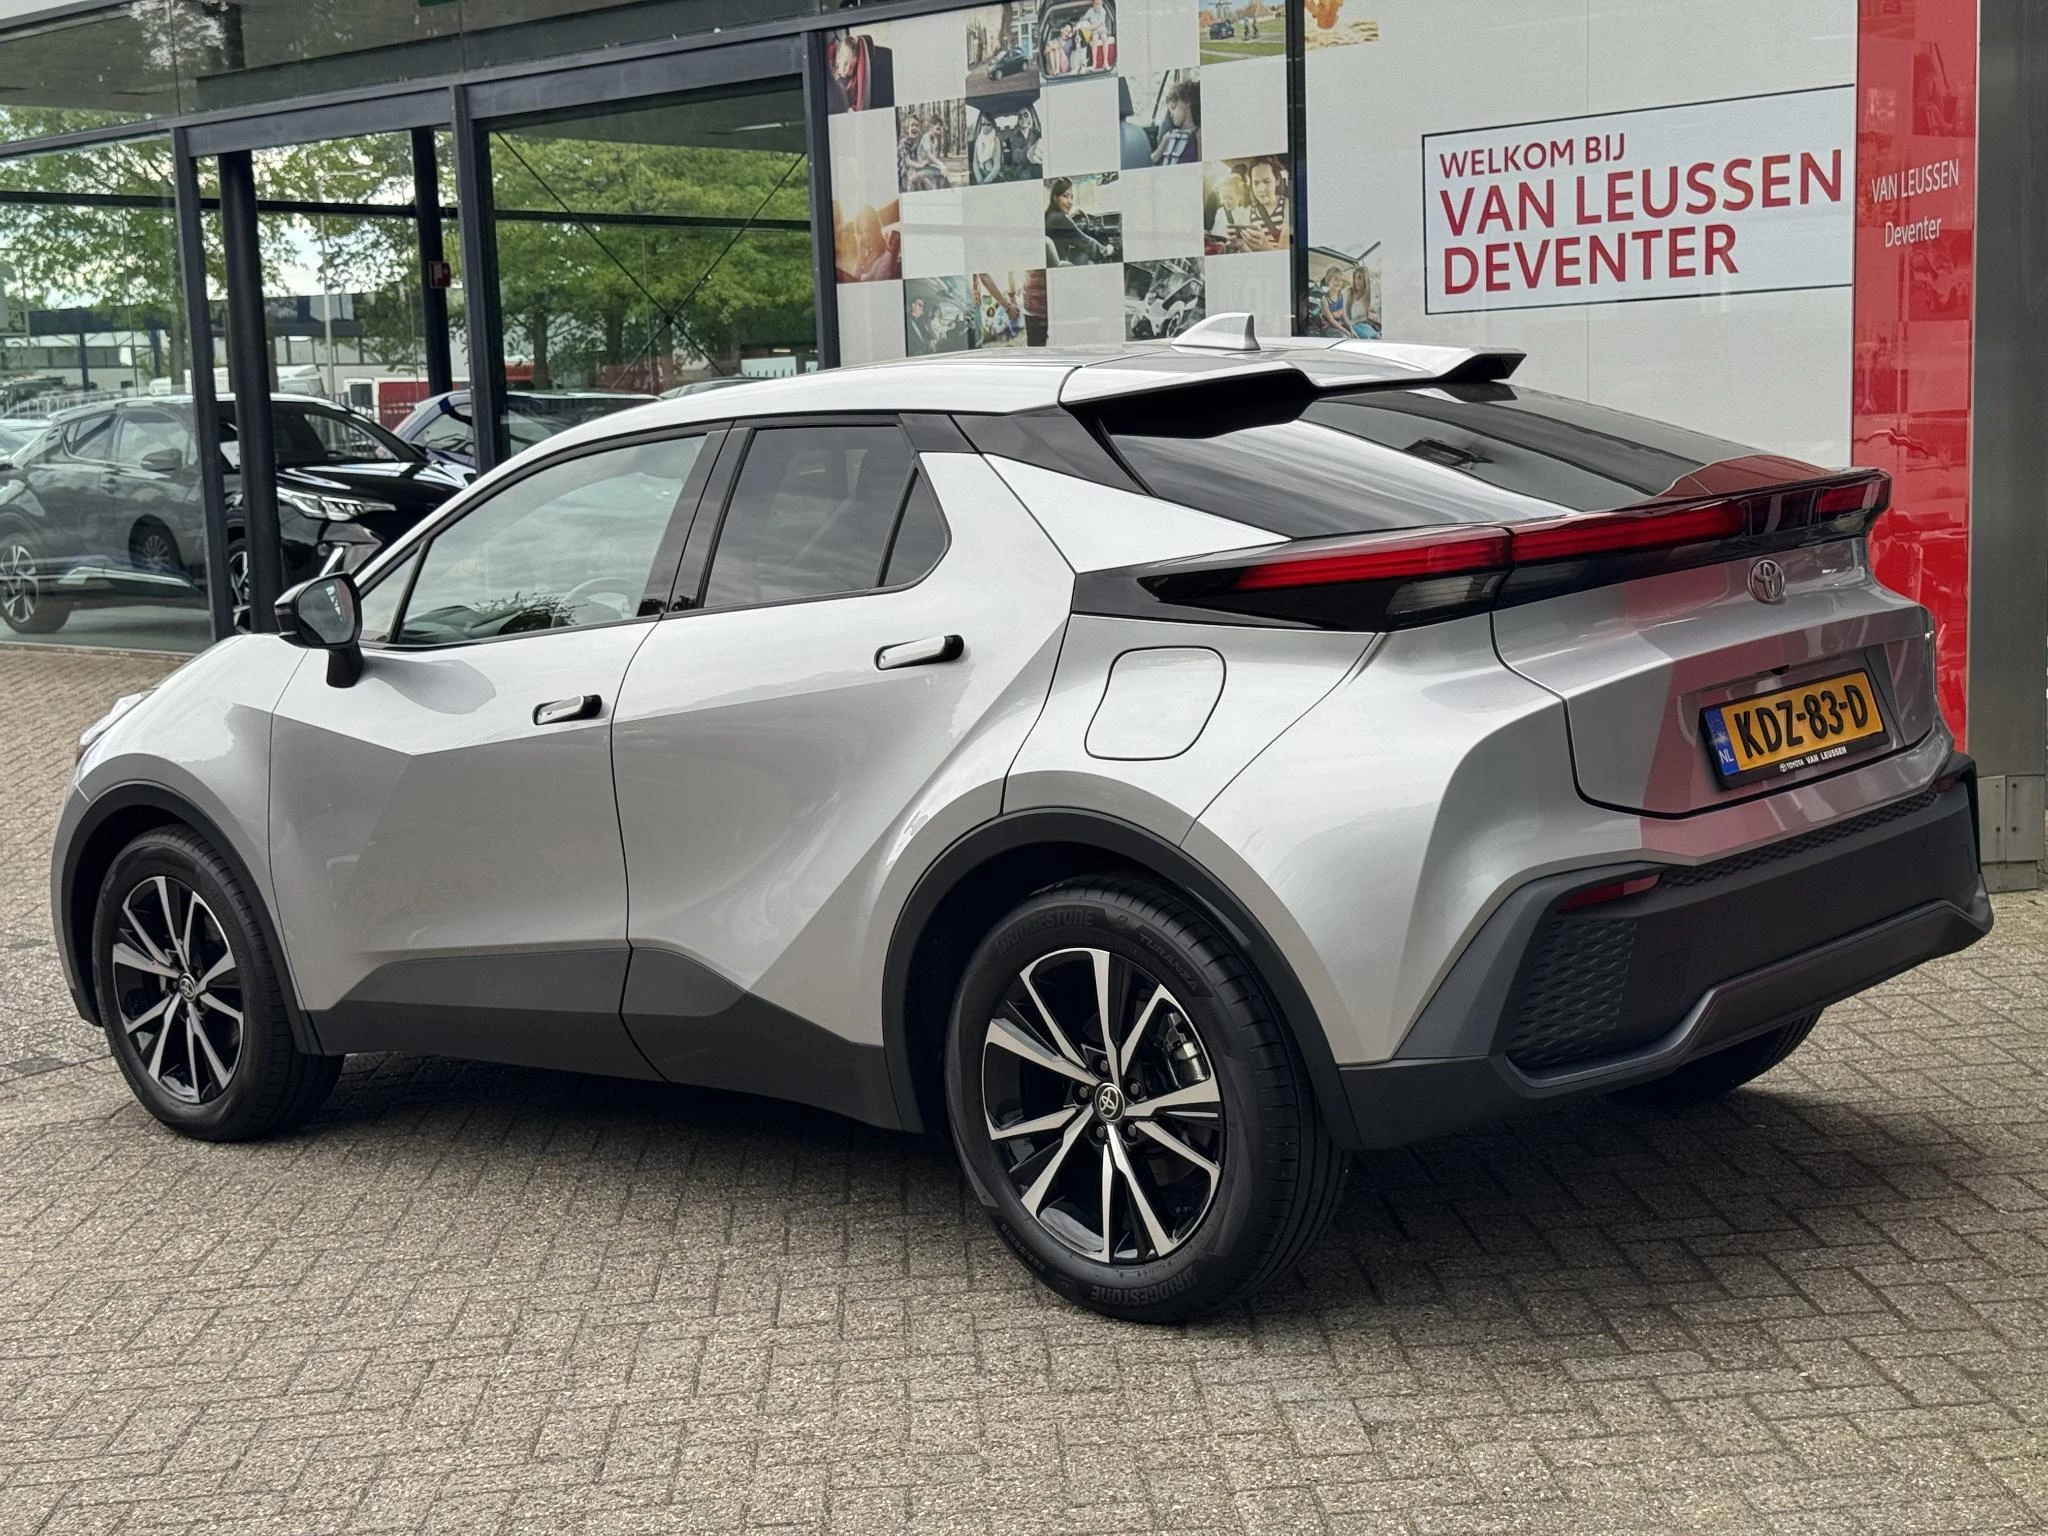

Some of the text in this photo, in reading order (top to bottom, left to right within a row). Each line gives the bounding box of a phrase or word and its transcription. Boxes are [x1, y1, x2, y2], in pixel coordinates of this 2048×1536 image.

[1440, 132, 1625, 179] WELKOM BIJ
[1440, 148, 1842, 237] VAN LEUSSEN
[1871, 158, 1960, 204] VAN LEUSSEN
[1885, 216, 1942, 248] Deventer
[1444, 223, 1740, 296] DEVENTER
[1733, 684, 1869, 760] KDZ-83-D
[1718, 749, 1735, 766] NL
[1786, 745, 1848, 770] TOYOTA VAN LEUSSEN
[1139, 932, 1199, 992] TURANZA
[1089, 1264, 1200, 1306] BRIDGESTONE
